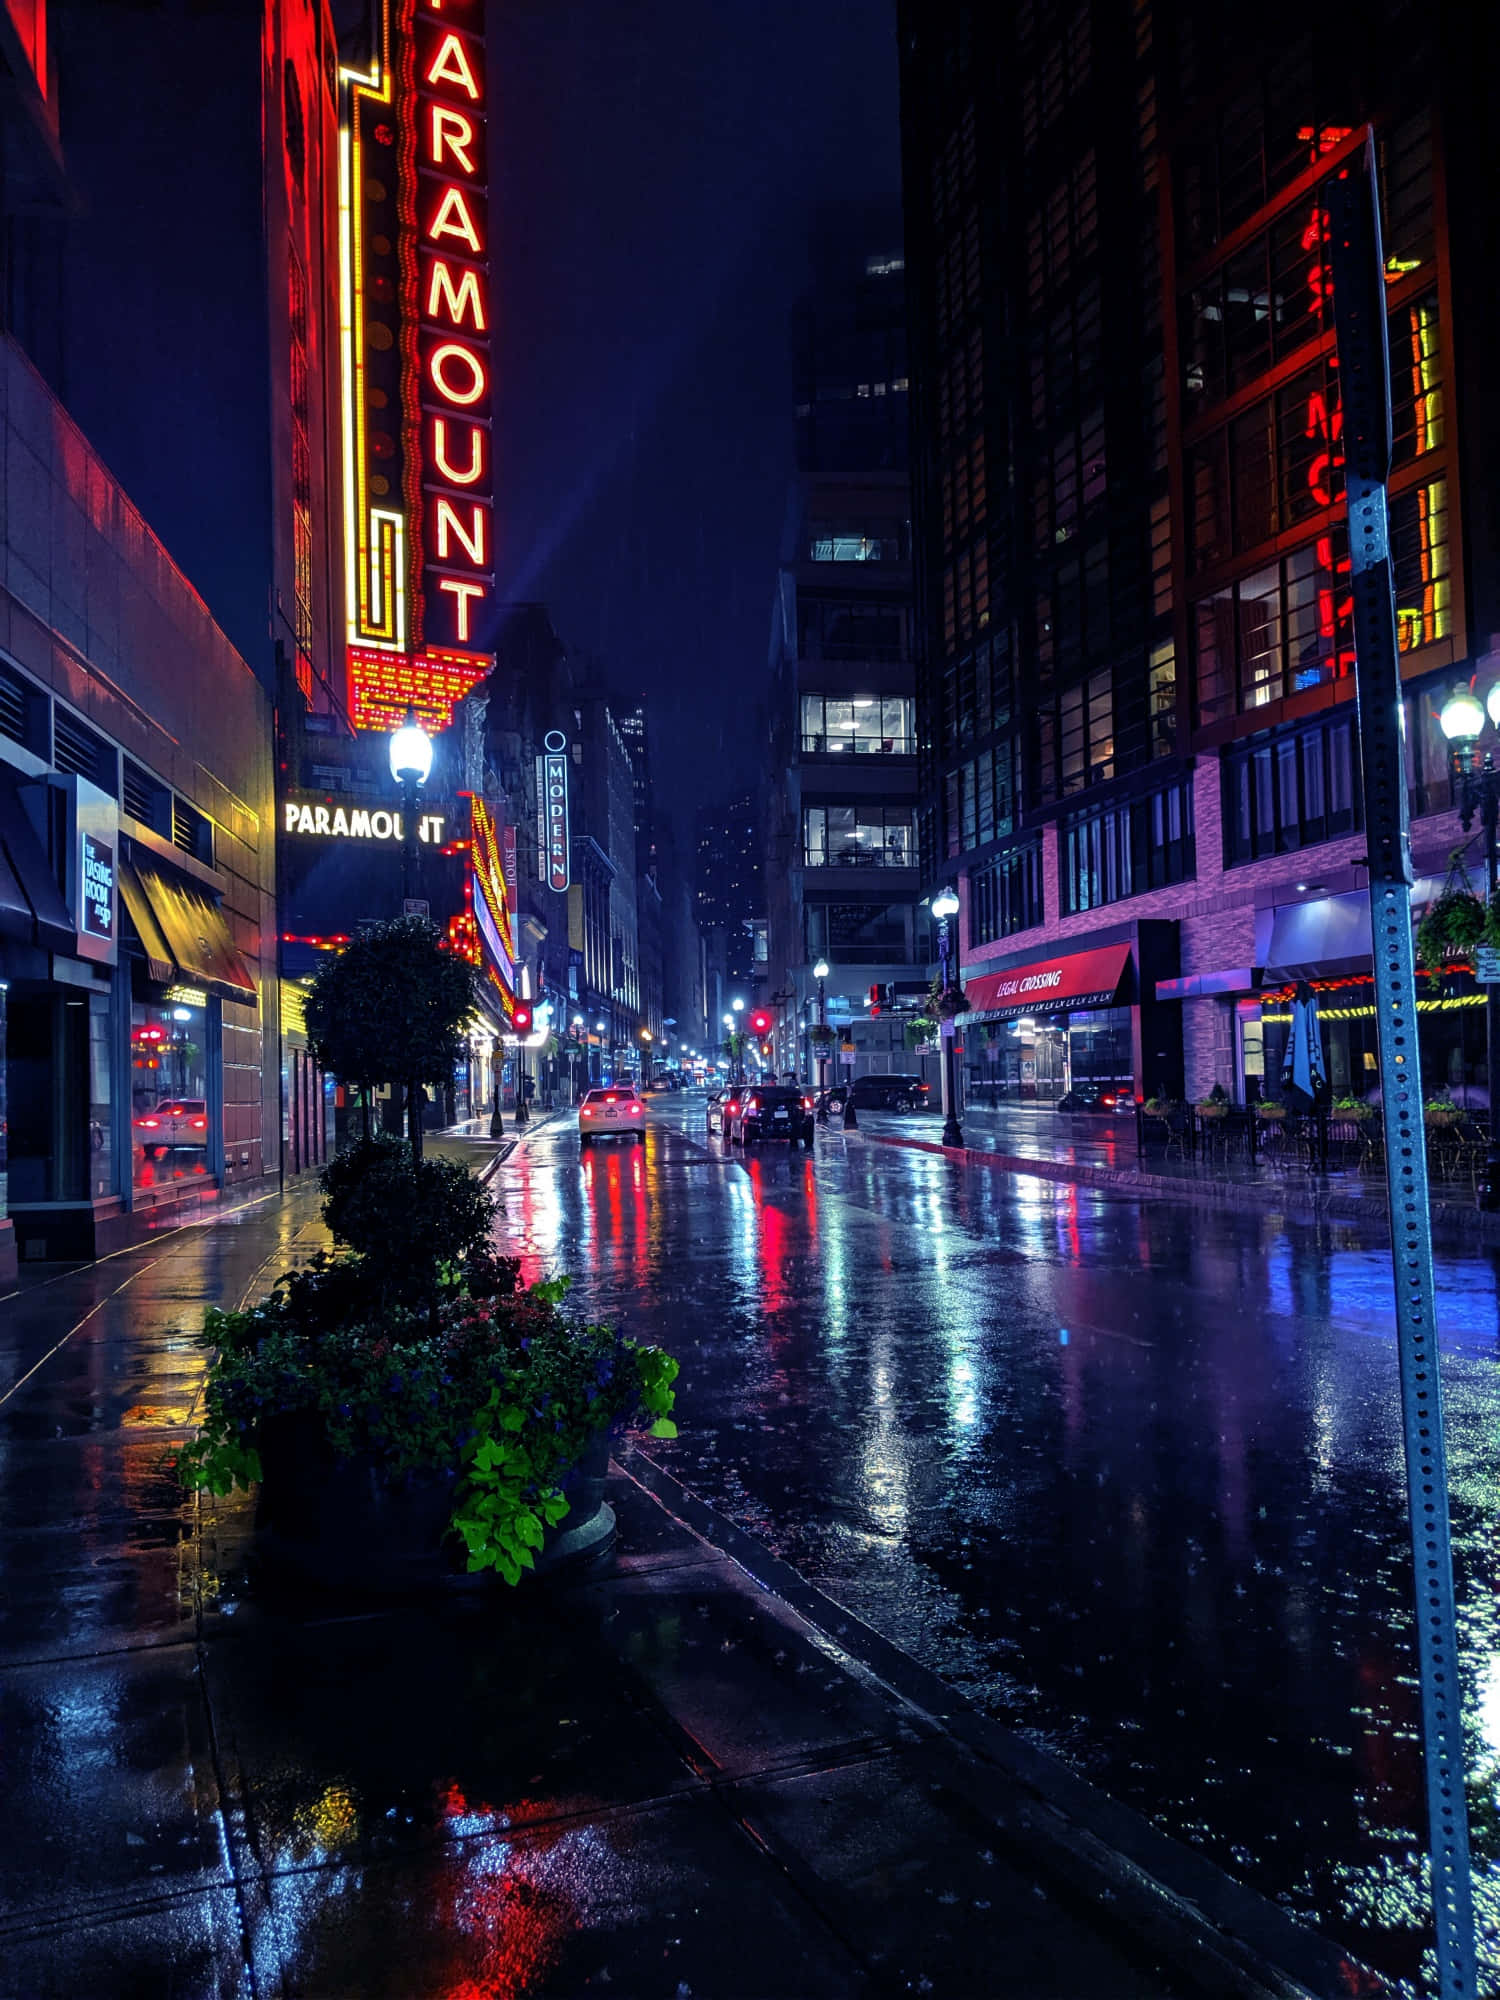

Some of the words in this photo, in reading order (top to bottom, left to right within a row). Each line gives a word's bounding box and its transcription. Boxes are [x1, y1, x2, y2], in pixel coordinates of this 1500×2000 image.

[427, 0, 486, 642] ARAMOUNT
[550, 765, 565, 876] MODERN
[506, 847, 516, 886] HOUSE
[86, 878, 108, 904] ROOM
[997, 979, 1019, 998] LEGAL
[1019, 970, 1063, 993] CROSSING
[1055, 1000, 1066, 1008] LX
[1066, 998, 1076, 1007] LX
[1076, 996, 1088, 1006] LX
[1088, 994, 1098, 1004] LX
[1100, 992, 1112, 1002] LX
